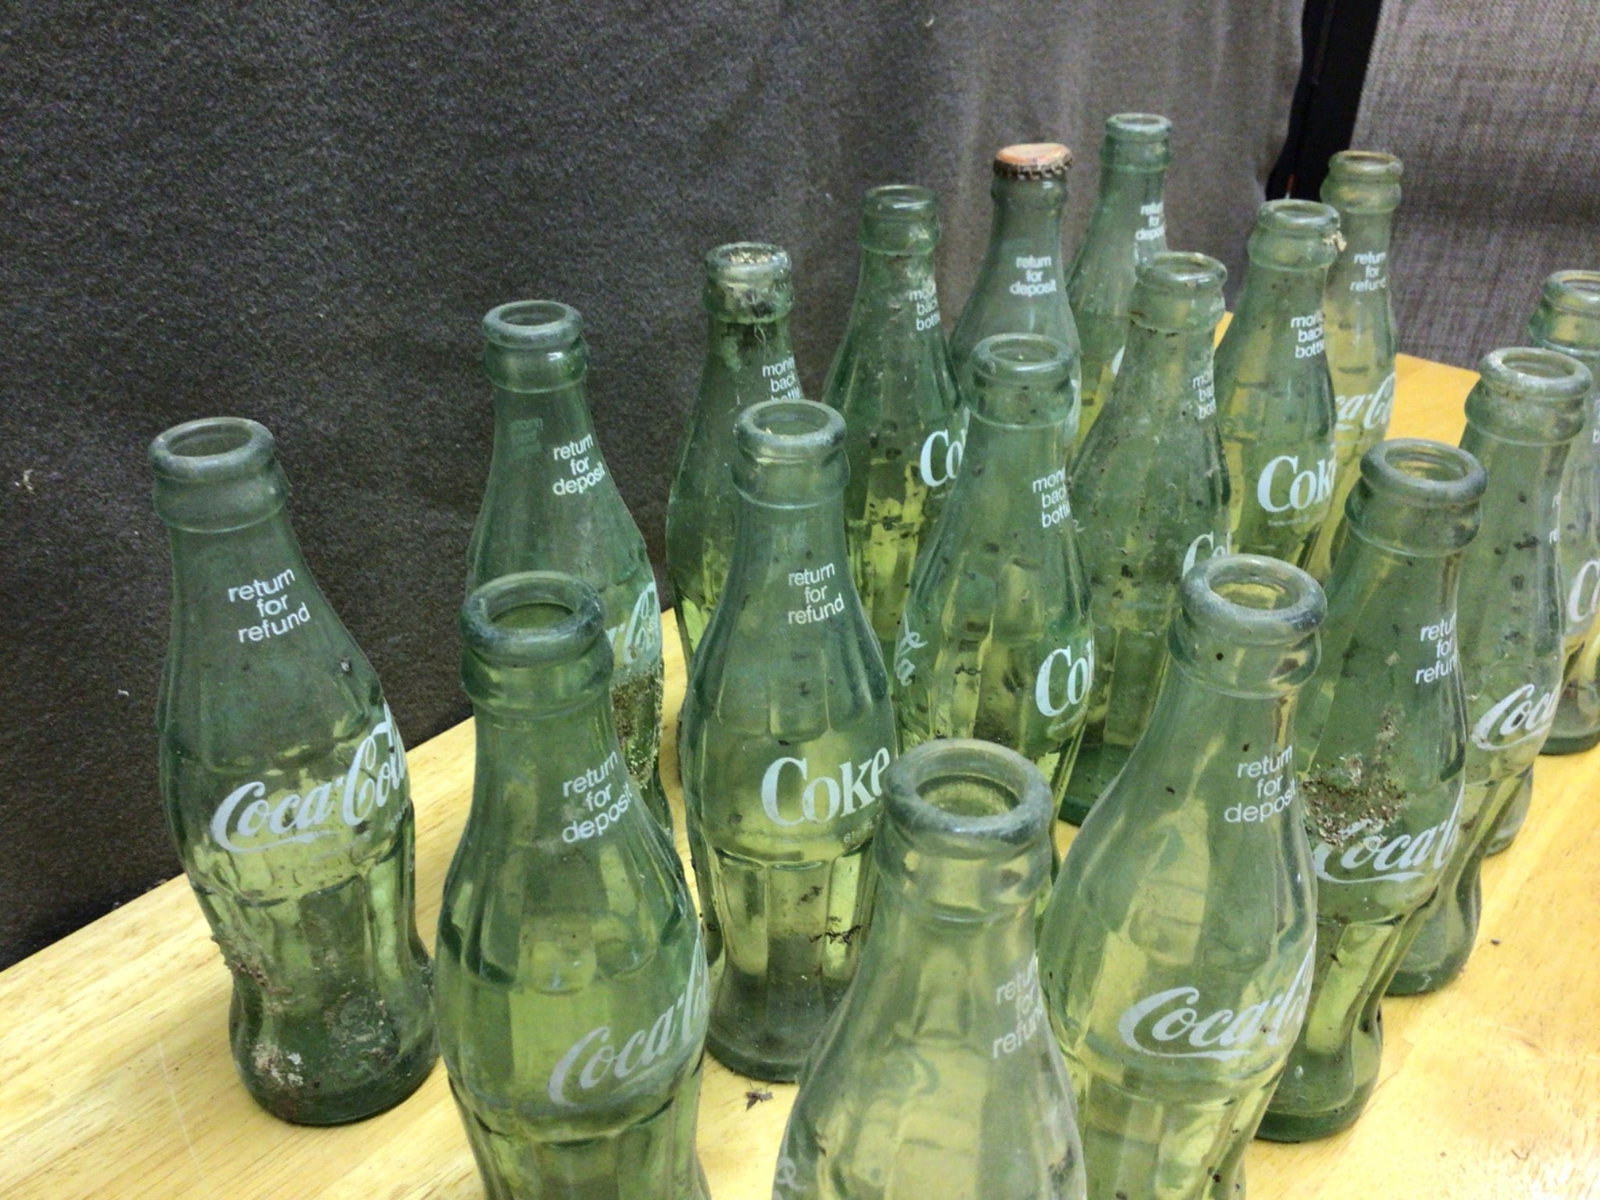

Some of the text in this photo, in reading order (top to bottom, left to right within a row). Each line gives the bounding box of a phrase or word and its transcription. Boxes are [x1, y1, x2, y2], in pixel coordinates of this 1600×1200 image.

[1025, 269, 1043, 283] for
[1365, 264, 1380, 279] for
[553, 433, 594, 461] return
[569, 456, 589, 475] for
[227, 568, 296, 603] return
[788, 562, 836, 587] return
[256, 594, 289, 618] for
[788, 592, 845, 625] refund
[804, 585, 828, 604] for
[238, 601, 311, 644] refund
[562, 751, 619, 798] return
[1237, 745, 1293, 778] return
[585, 783, 612, 812] for
[761, 747, 890, 828] Coke
[1224, 778, 1297, 823] deposit
[1257, 775, 1284, 799] for
[562, 782, 633, 844] deposit
